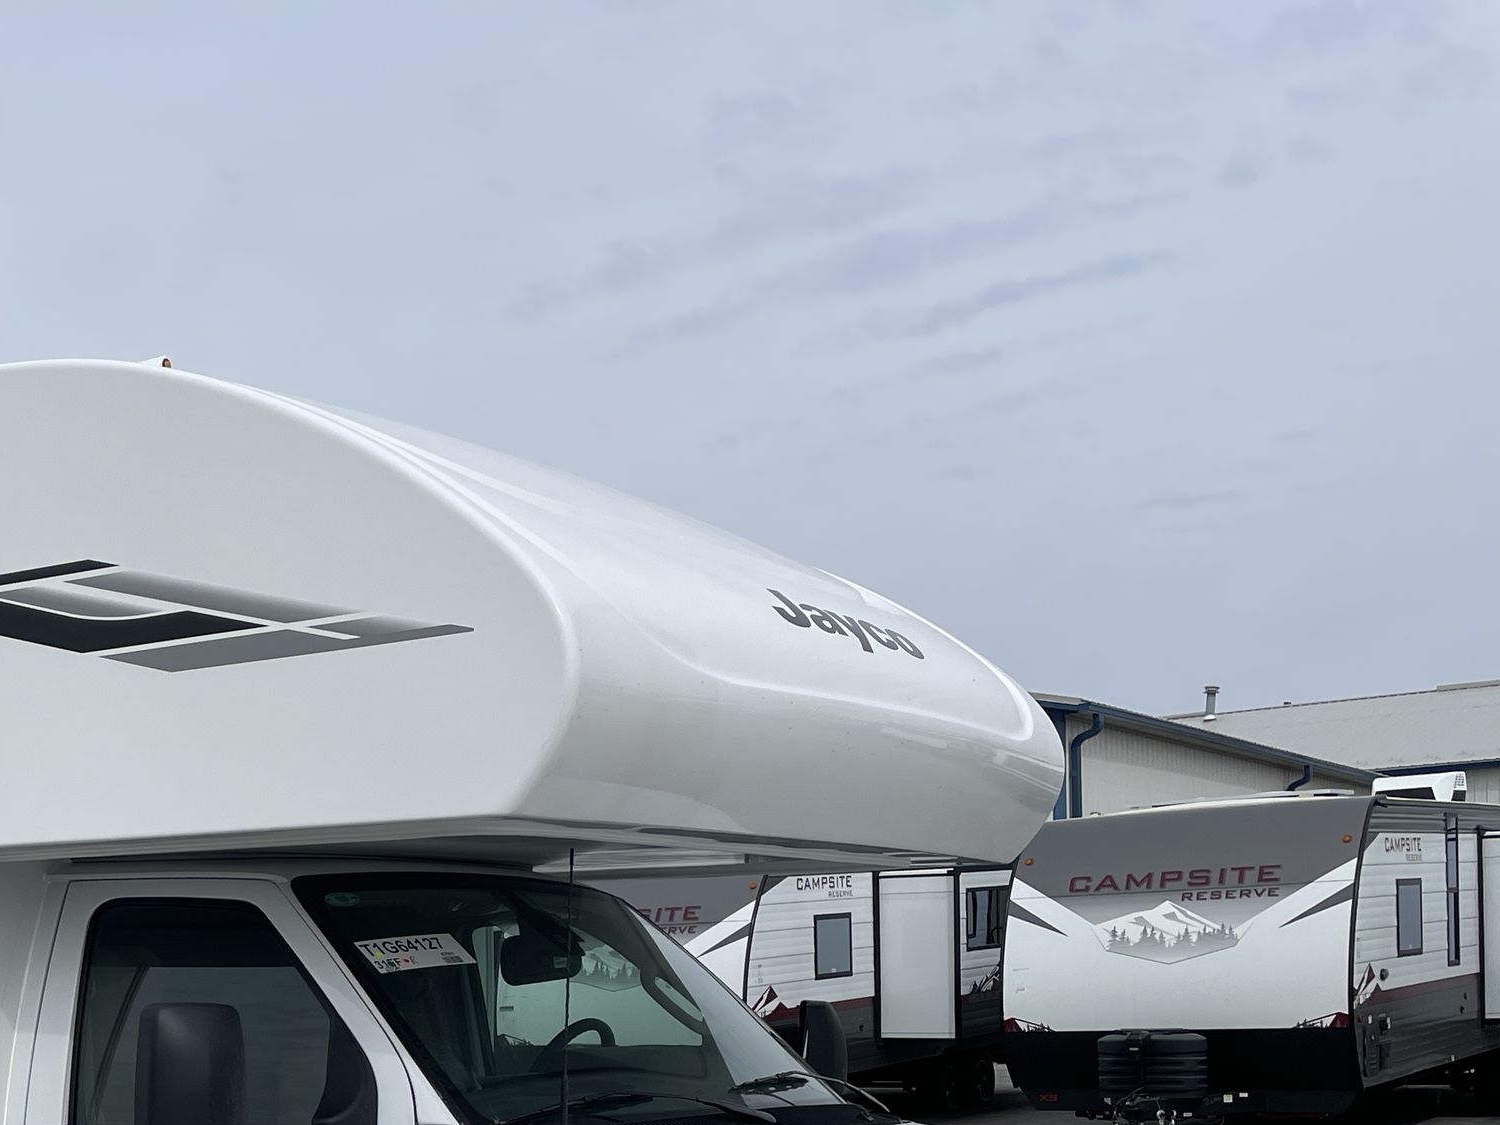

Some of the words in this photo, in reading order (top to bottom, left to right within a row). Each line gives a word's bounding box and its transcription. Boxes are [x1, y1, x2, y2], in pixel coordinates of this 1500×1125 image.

[766, 588, 924, 660] Jayco
[1384, 837, 1422, 852] CAMPSITE
[796, 875, 852, 891] CAMPSITE
[1069, 865, 1282, 893] CAMPSITE
[828, 890, 853, 898] RESERVE
[1181, 887, 1280, 902] RESERVE
[359, 937, 443, 957] T1G64127
